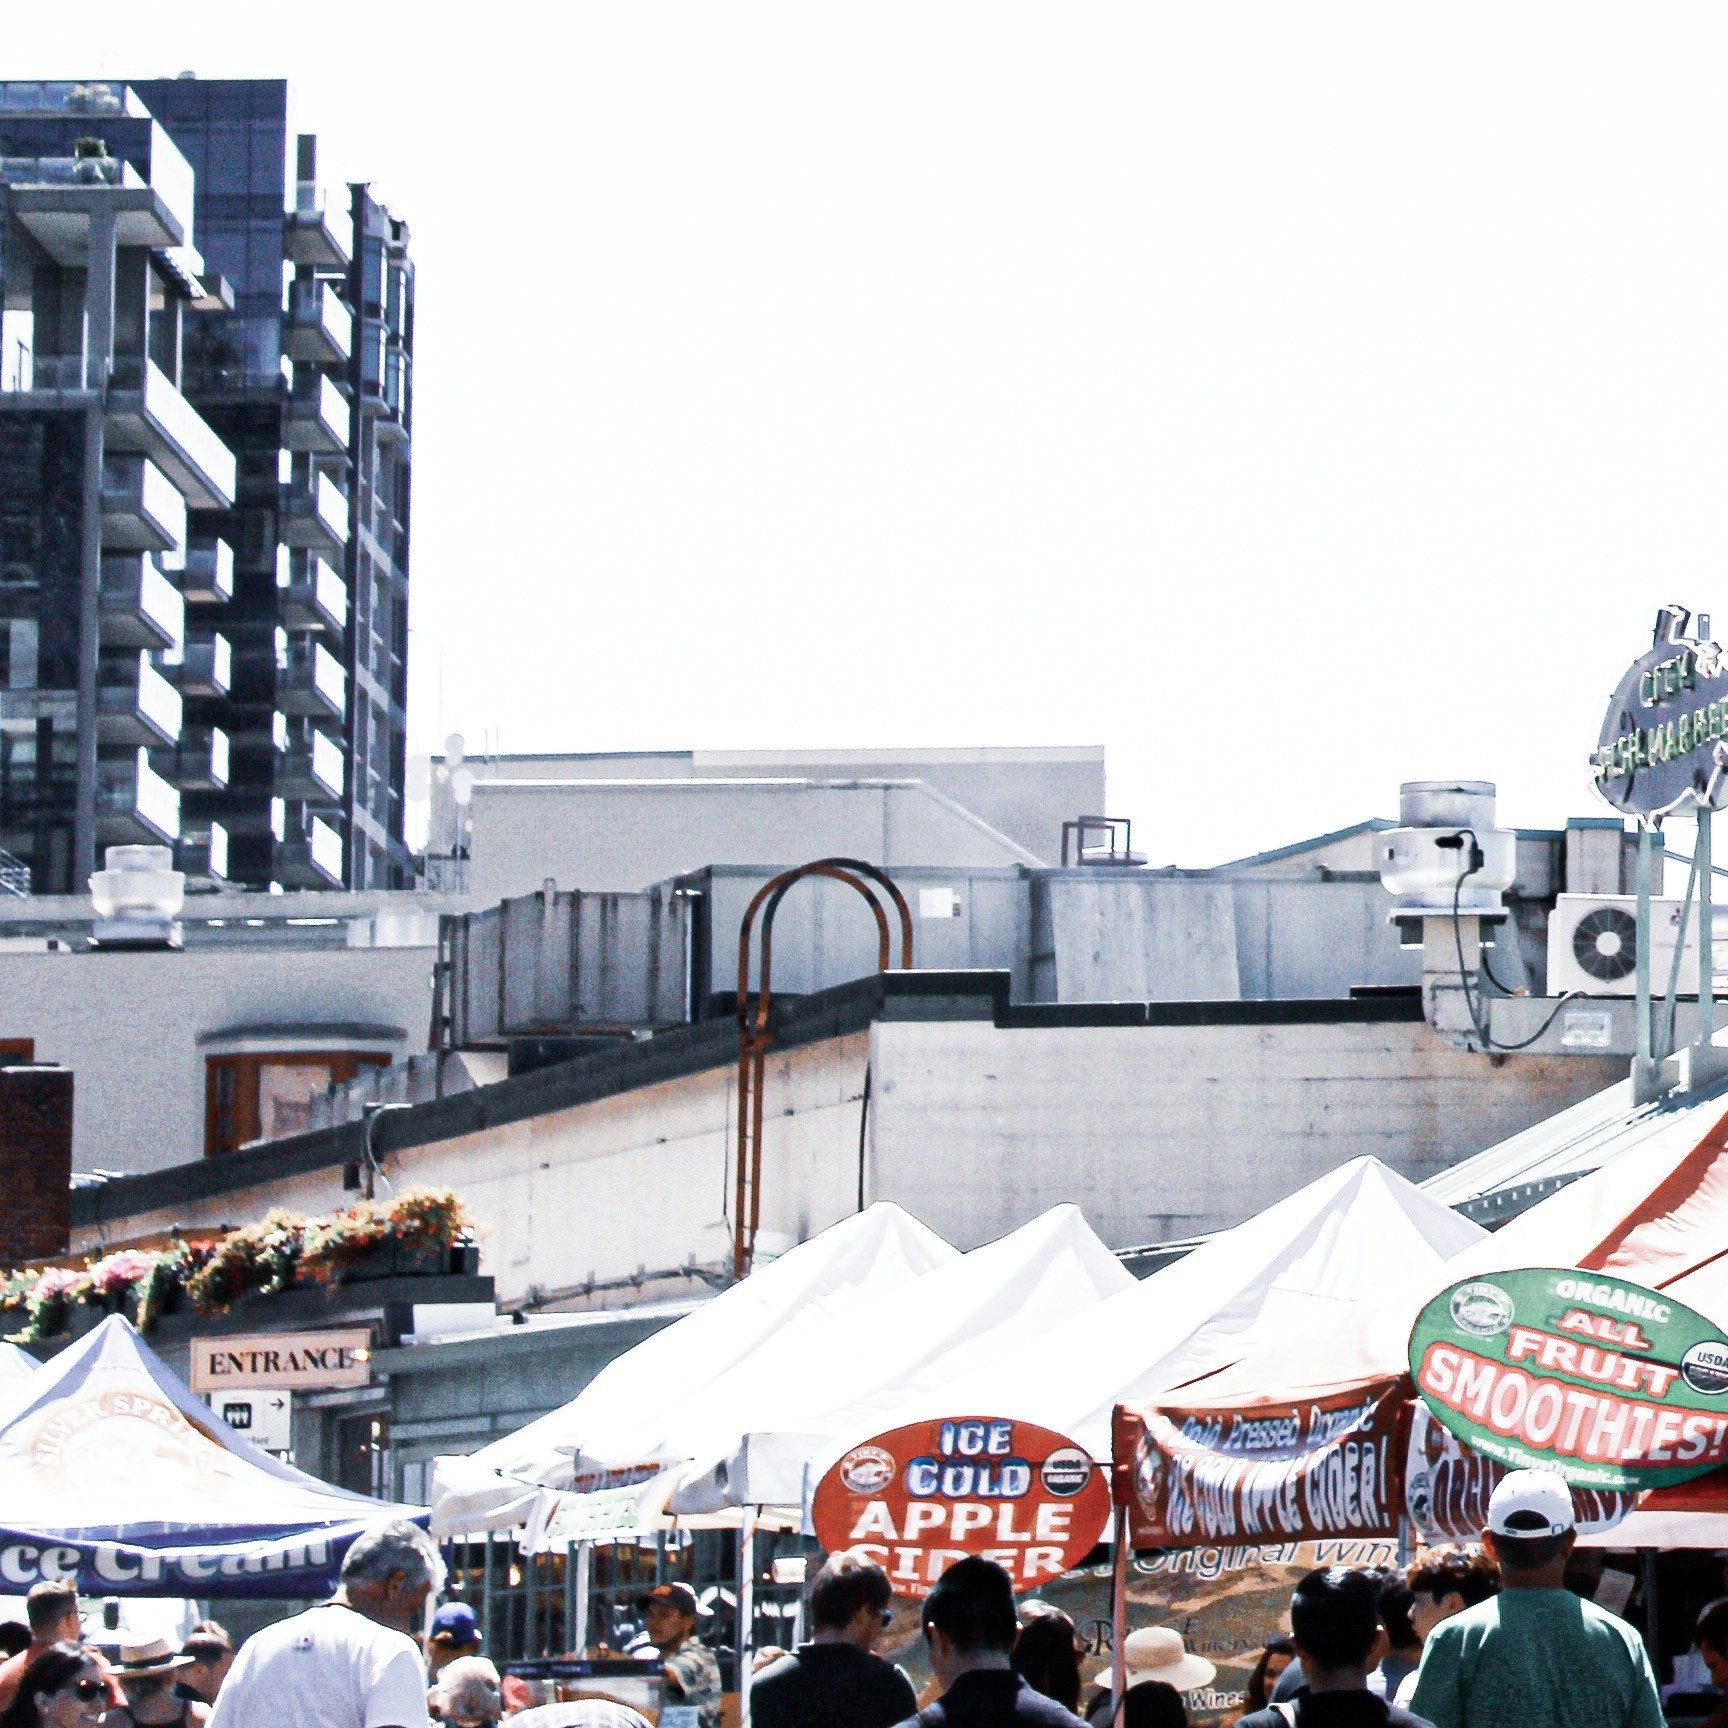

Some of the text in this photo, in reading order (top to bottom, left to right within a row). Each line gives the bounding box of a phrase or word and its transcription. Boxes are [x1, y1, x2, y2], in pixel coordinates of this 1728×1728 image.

[1639, 650, 1696, 708] CITY
[1555, 1278, 1672, 1324] ORGANIC
[1559, 1310, 1651, 1349] ALL
[210, 1347, 355, 1375] ENTRANCE
[1509, 1330, 1679, 1394] FRUIT
[34, 1399, 110, 1466] SILVER
[941, 1421, 1013, 1456] ICE
[1223, 1408, 1301, 1450] Pressed
[907, 1457, 1032, 1498] COLD
[1304, 1435, 1391, 1532] CIDER!
[850, 1500, 1074, 1542] APPLE
[0, 1544, 80, 1584] ce
